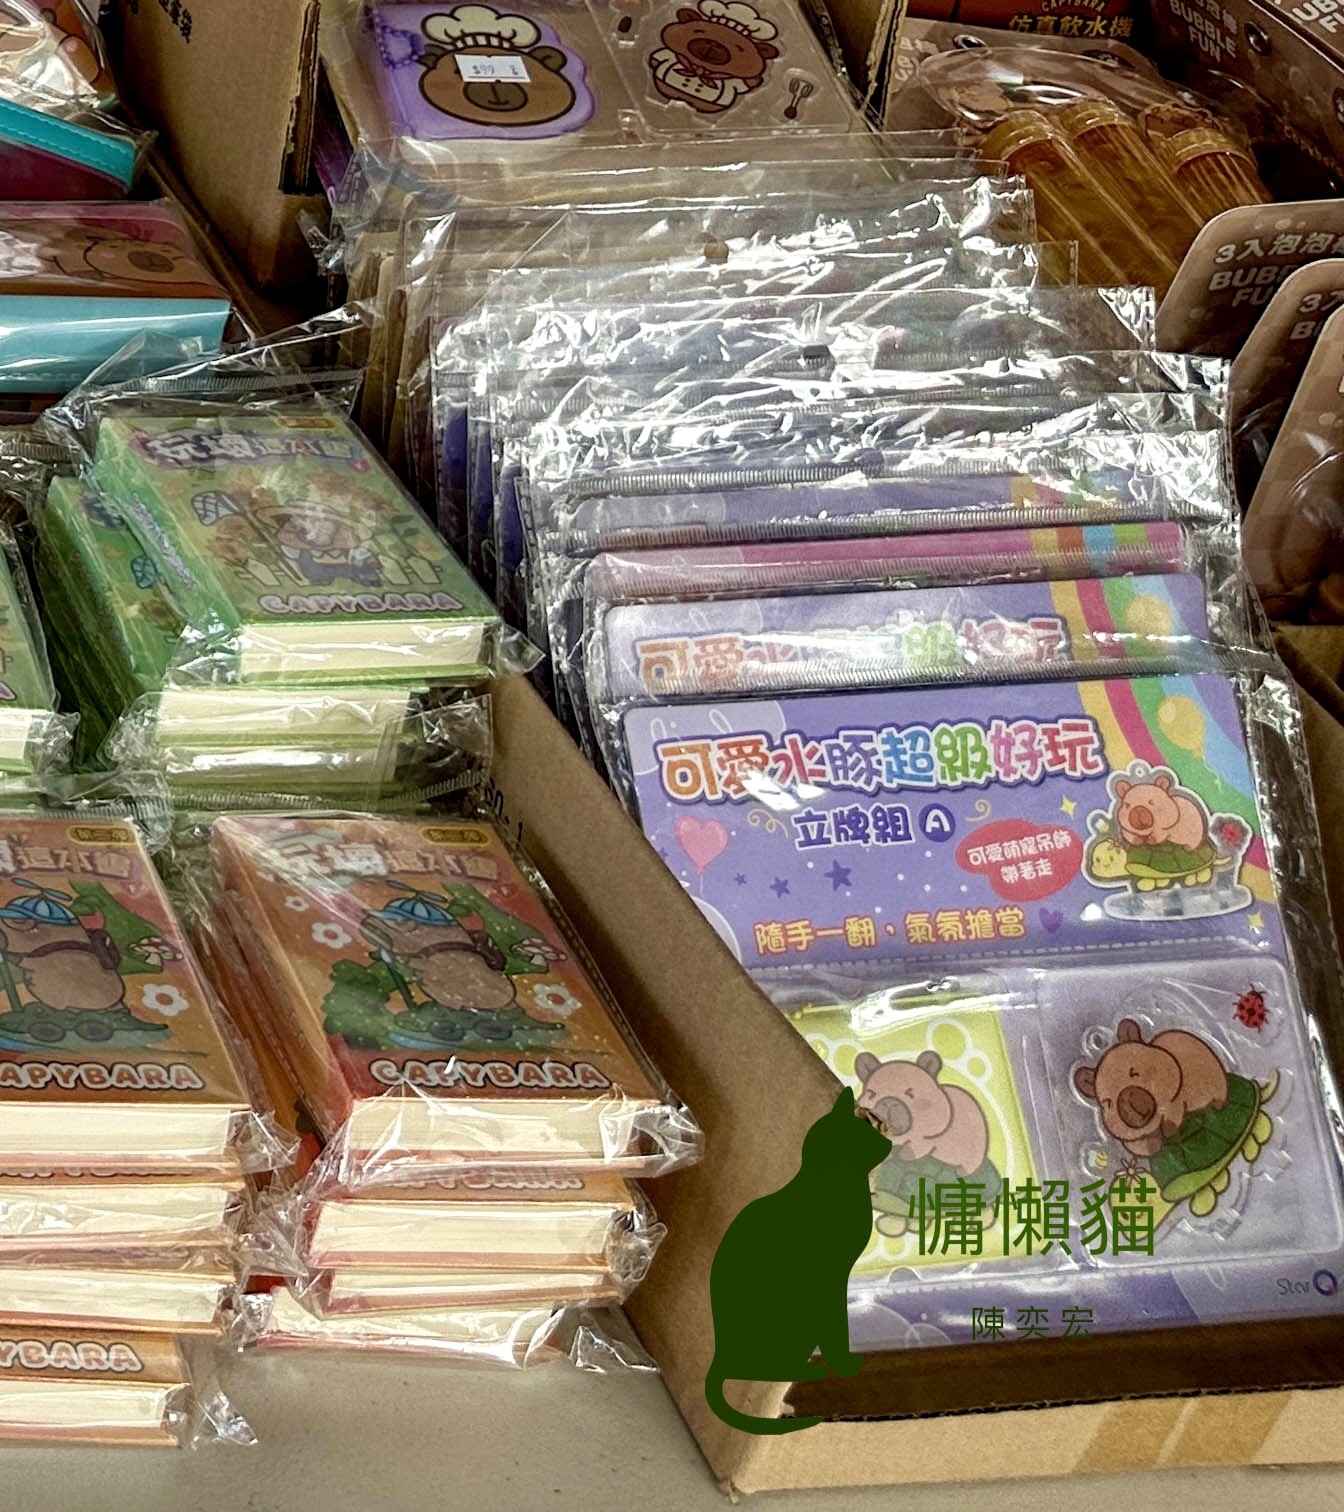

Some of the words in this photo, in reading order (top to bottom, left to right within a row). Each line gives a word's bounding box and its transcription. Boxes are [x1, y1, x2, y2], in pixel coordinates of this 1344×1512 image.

[1190, 29, 1221, 63] FUN
[258, 591, 462, 614] CAPYBARA
[657, 719, 1104, 799] 可愛水豚超級好玩
[793, 804, 913, 849] 立牌組
[967, 829, 1073, 866] 可愛萌寵吊飾
[1000, 859, 1053, 882] 帶著走
[372, 1056, 611, 1090] CAPYBARA
